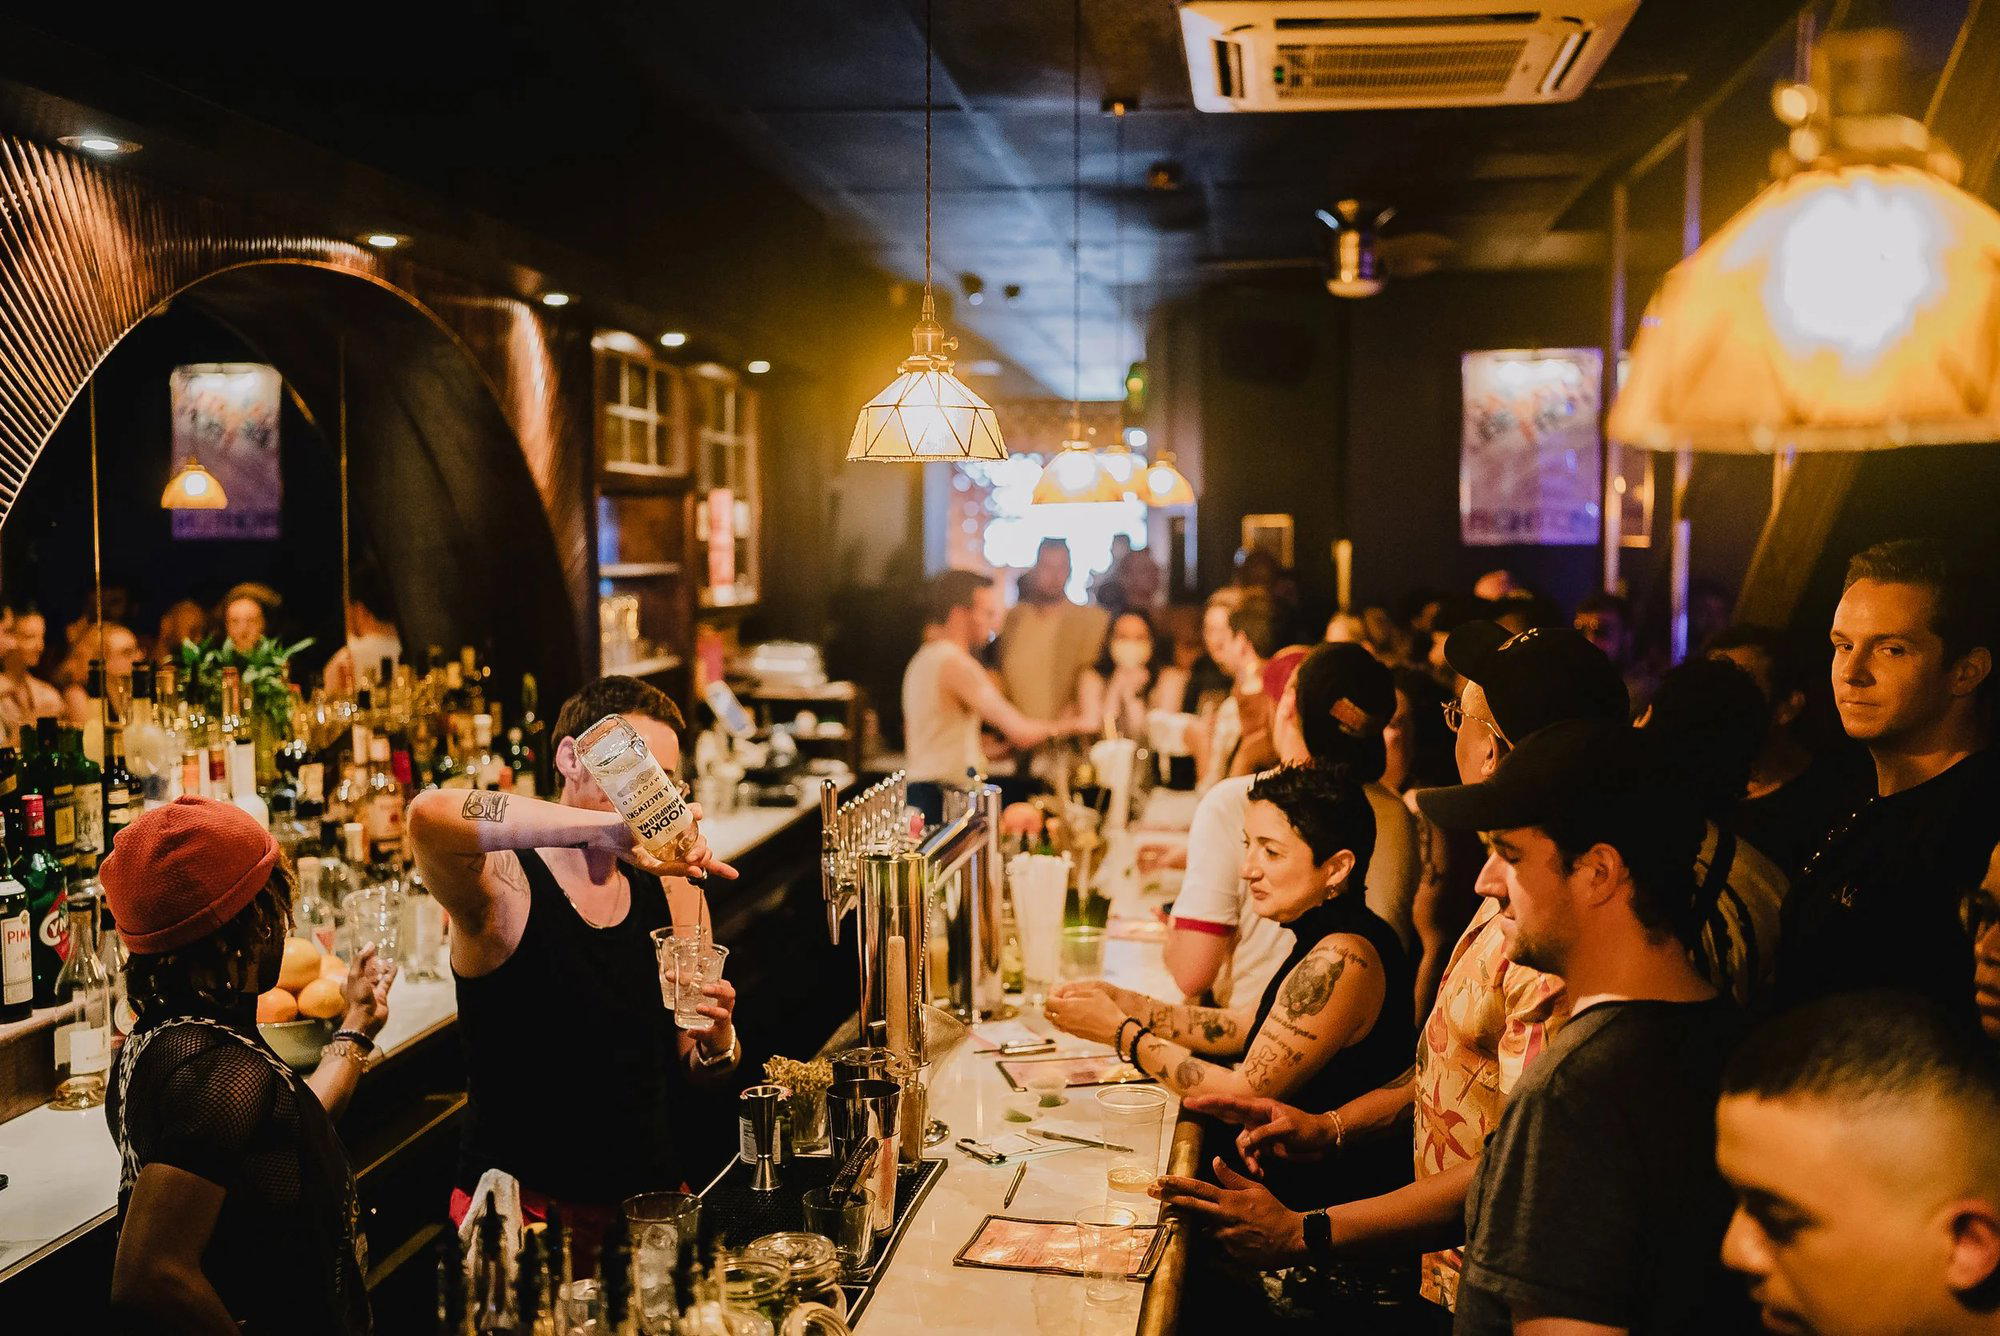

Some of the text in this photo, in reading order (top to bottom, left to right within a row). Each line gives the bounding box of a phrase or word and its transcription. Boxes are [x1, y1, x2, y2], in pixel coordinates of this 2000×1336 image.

[626, 791, 664, 820] BACZEWSKI
[636, 796, 680, 832] MONOPOLOWA
[640, 803, 686, 840] VODKA
